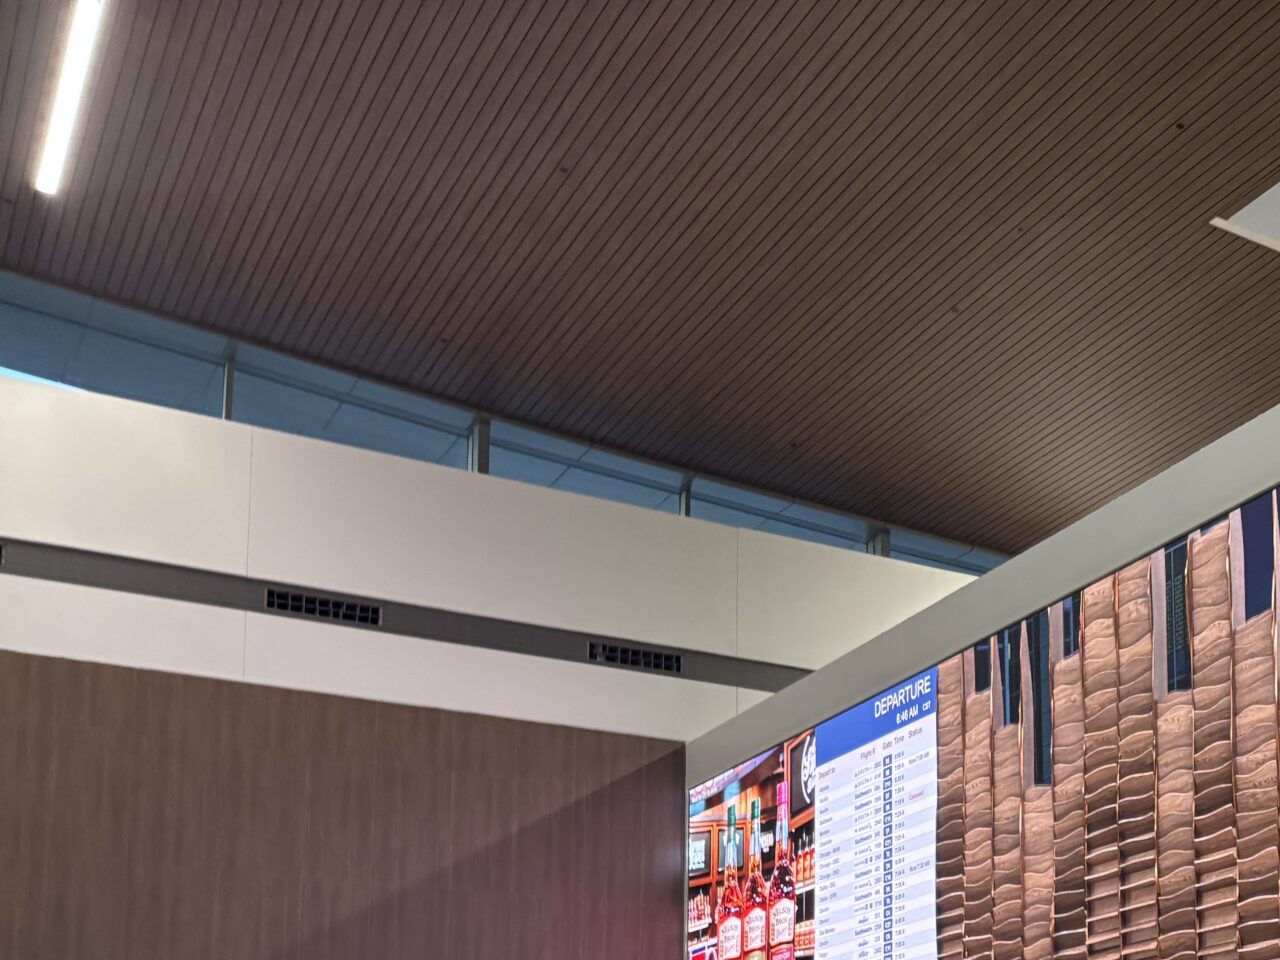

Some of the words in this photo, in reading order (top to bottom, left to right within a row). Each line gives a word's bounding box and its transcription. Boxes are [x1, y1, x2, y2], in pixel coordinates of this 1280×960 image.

[874, 675, 931, 718] DEPARTURE
[909, 704, 919, 719] AM
[894, 735, 905, 745] Time
